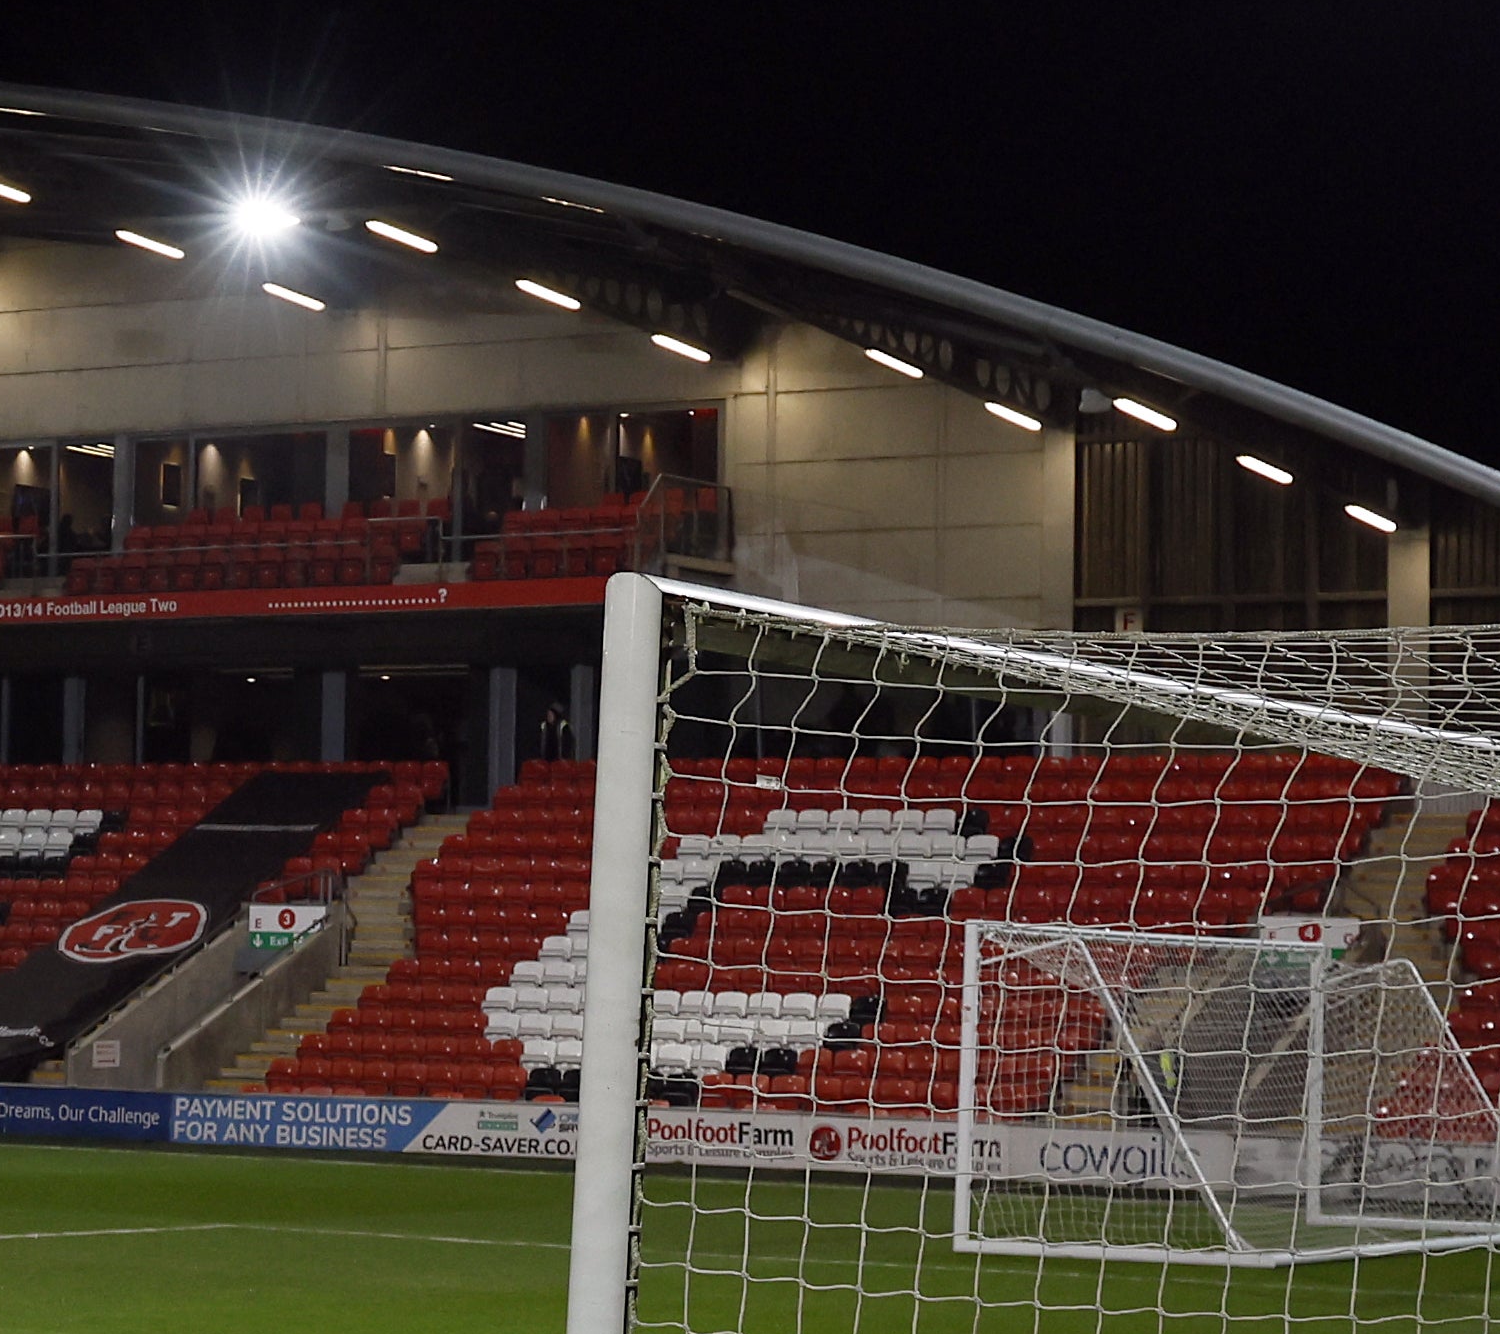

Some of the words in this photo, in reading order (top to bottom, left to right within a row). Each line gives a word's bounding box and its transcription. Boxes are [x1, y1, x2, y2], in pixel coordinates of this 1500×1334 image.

[46, 599, 97, 616] Football
[100, 598, 146, 617] League
[150, 597, 178, 612] Two
[255, 918, 262, 929] E
[282, 912, 291, 926] 3
[270, 935, 289, 946] Exit
[1, 1102, 55, 1121] Dreams,
[58, 1104, 84, 1122] Our
[88, 1106, 161, 1129] Challenge
[175, 1098, 276, 1121] PAYMENT
[282, 1101, 413, 1126] SOLUTIONS
[173, 1121, 217, 1142] FOR
[223, 1122, 271, 1144] ANY
[276, 1124, 388, 1148] BUSINESS
[648, 1118, 794, 1146] PoolfootFarm
[422, 1135, 579, 1155] CARD-SAVER.CO.
